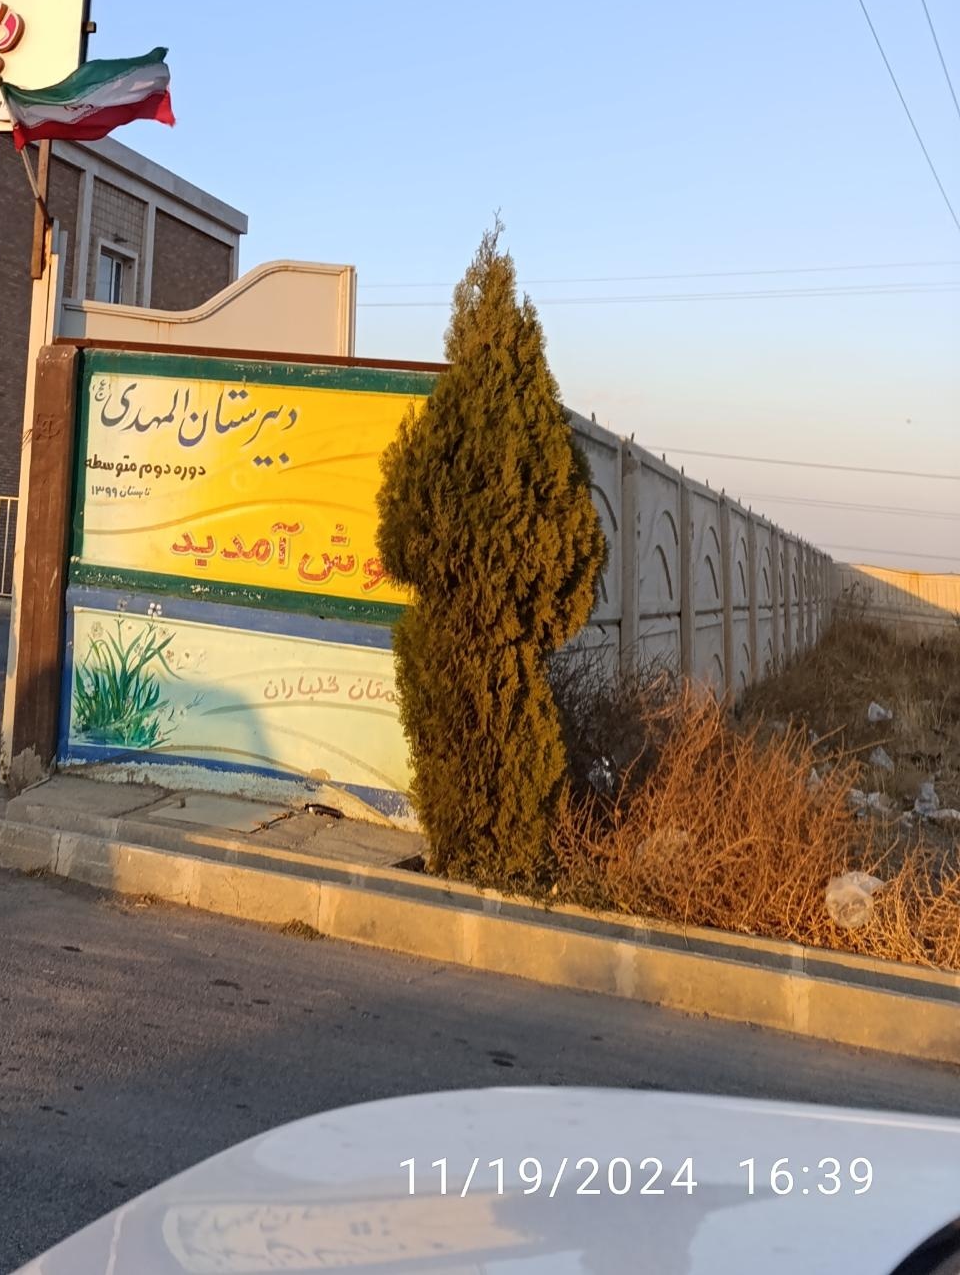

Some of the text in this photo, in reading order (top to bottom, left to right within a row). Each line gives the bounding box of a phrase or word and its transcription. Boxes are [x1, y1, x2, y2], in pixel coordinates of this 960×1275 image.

[100, 382, 190, 432] المهدی
[178, 388, 298, 467] دبیرستان
[84, 454, 206, 480] دوره دوم متوسطه
[91, 485, 118, 498] ۱۳۹۹
[171, 522, 386, 591] وش آمدید
[264, 675, 340, 701] گلباران
